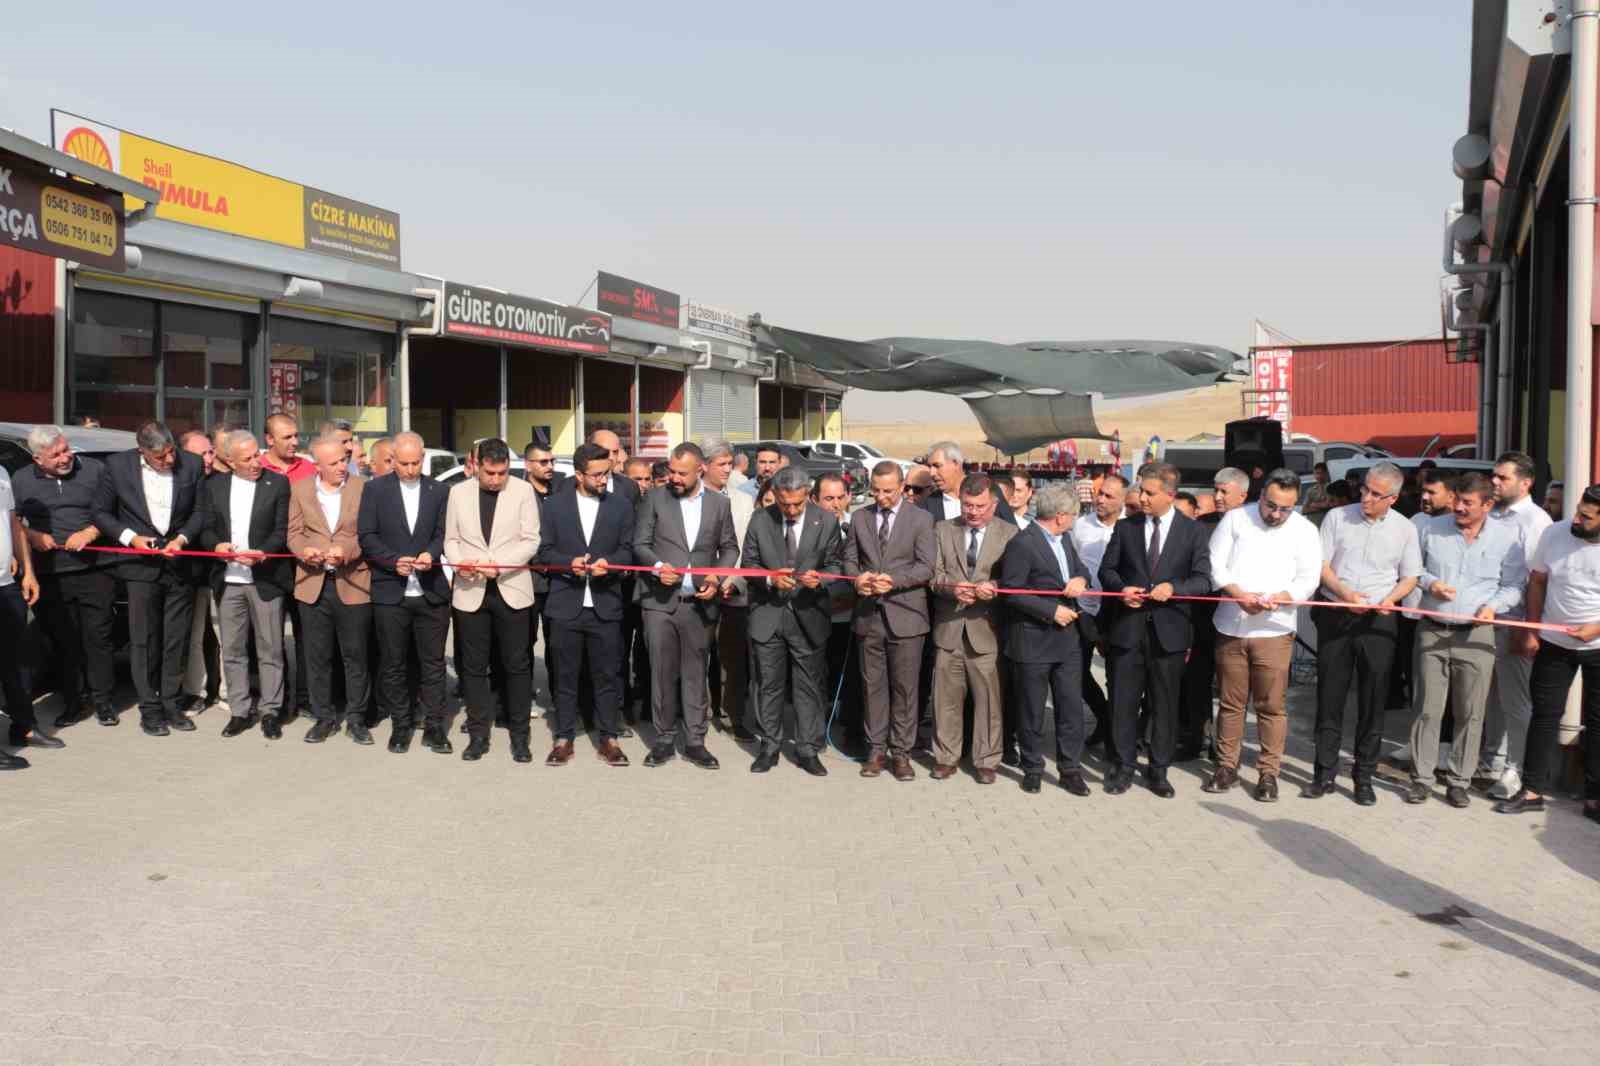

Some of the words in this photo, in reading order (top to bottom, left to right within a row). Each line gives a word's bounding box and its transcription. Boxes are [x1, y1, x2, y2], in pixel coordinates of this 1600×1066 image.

[143, 158, 172, 178] Shell
[46, 194, 69, 213] 0542
[46, 218, 69, 237] 0506
[347, 211, 396, 241] MAKİNA
[448, 289, 492, 325] GÜRE
[494, 303, 566, 338] OTOMOTİV
